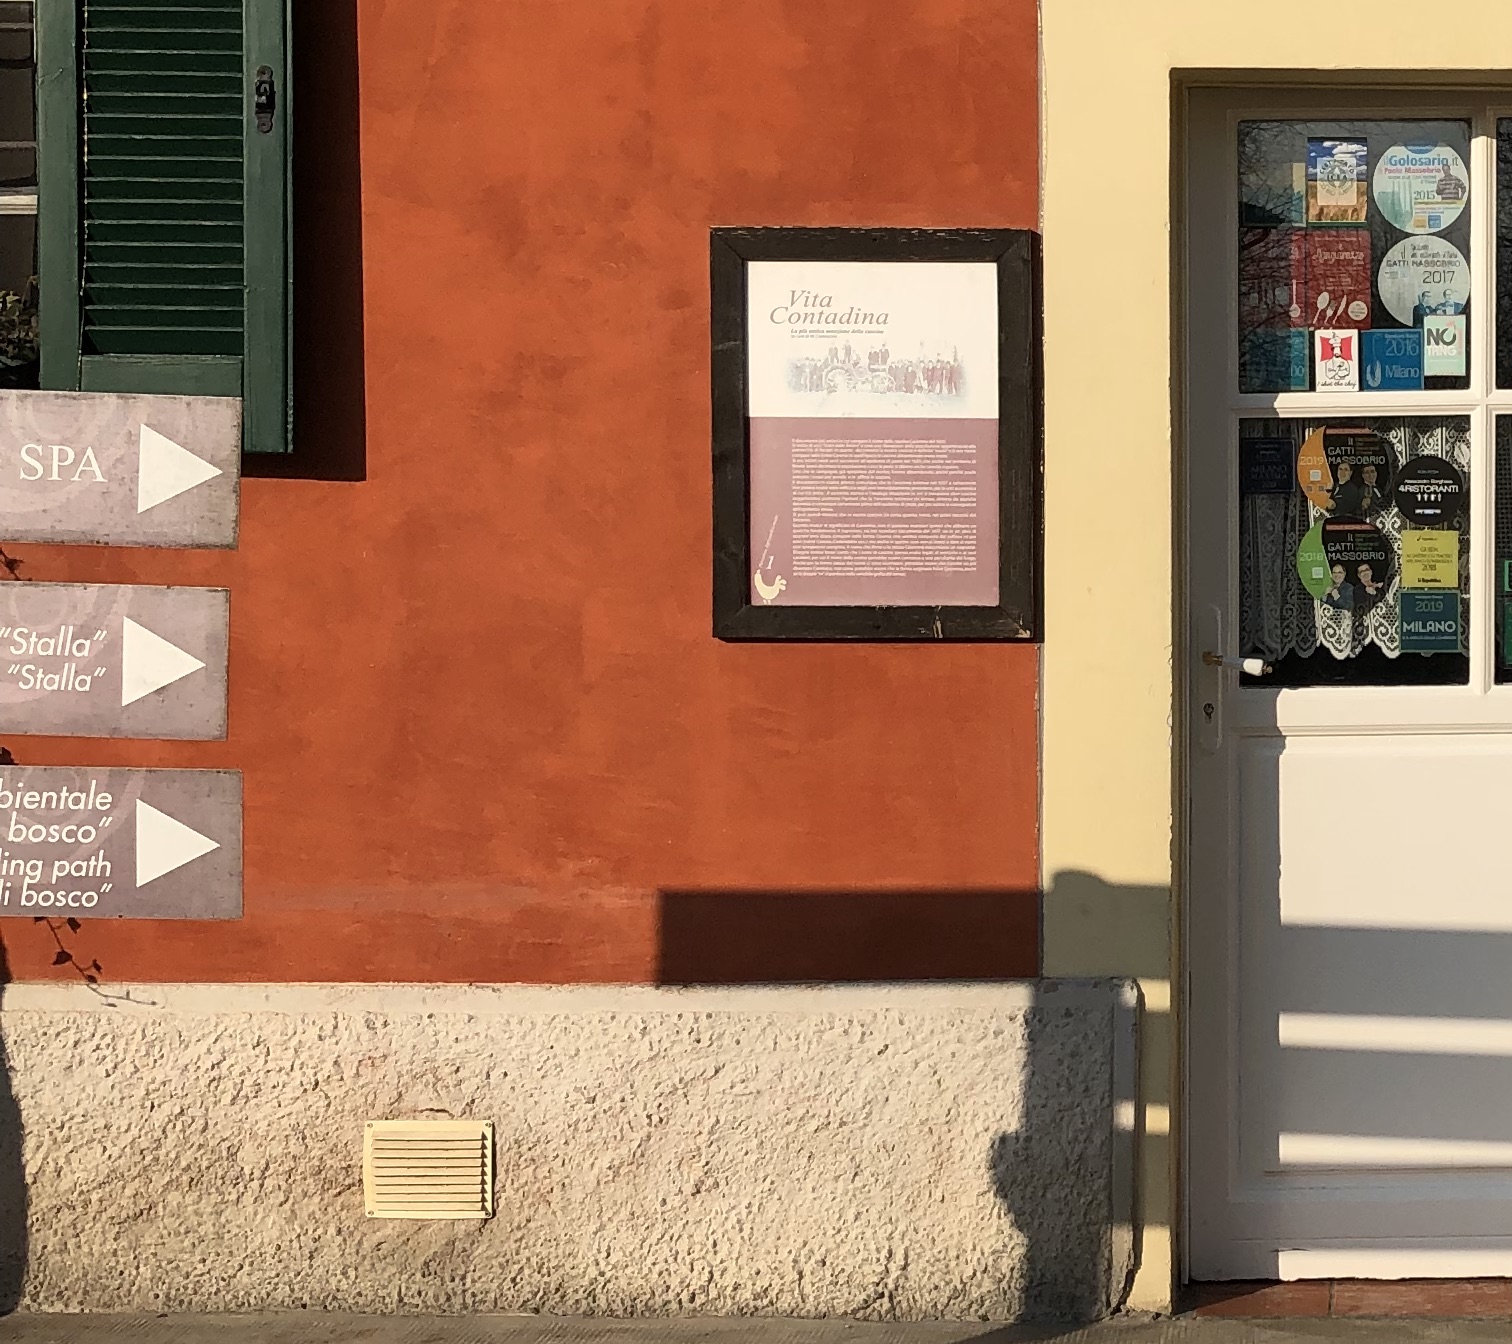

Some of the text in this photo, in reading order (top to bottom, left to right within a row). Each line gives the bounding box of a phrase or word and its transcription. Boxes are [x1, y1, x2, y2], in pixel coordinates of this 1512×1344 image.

[1413, 190, 1436, 201] 2015
[1422, 270, 1456, 284] 2017
[789, 289, 833, 308] Vita
[769, 306, 890, 325] Contadina
[1385, 338, 1419, 356] 2016
[1385, 364, 1420, 378] Milano
[1327, 446, 1355, 456] GATTI
[19, 443, 108, 483] SPA
[1300, 456, 1325, 466] 2019
[1328, 456, 1386, 465] MASSOBRIO
[1327, 542, 1355, 551] GATTI
[1328, 551, 1386, 561] MASSOBRIO
[1415, 600, 1444, 612] 2019
[1402, 620, 1457, 633] MILANO
[7, 662, 107, 692] "Stalla"
[7, 810, 113, 844] bosco"
[51, 849, 112, 885] path
[20, 875, 113, 908] bosco"
